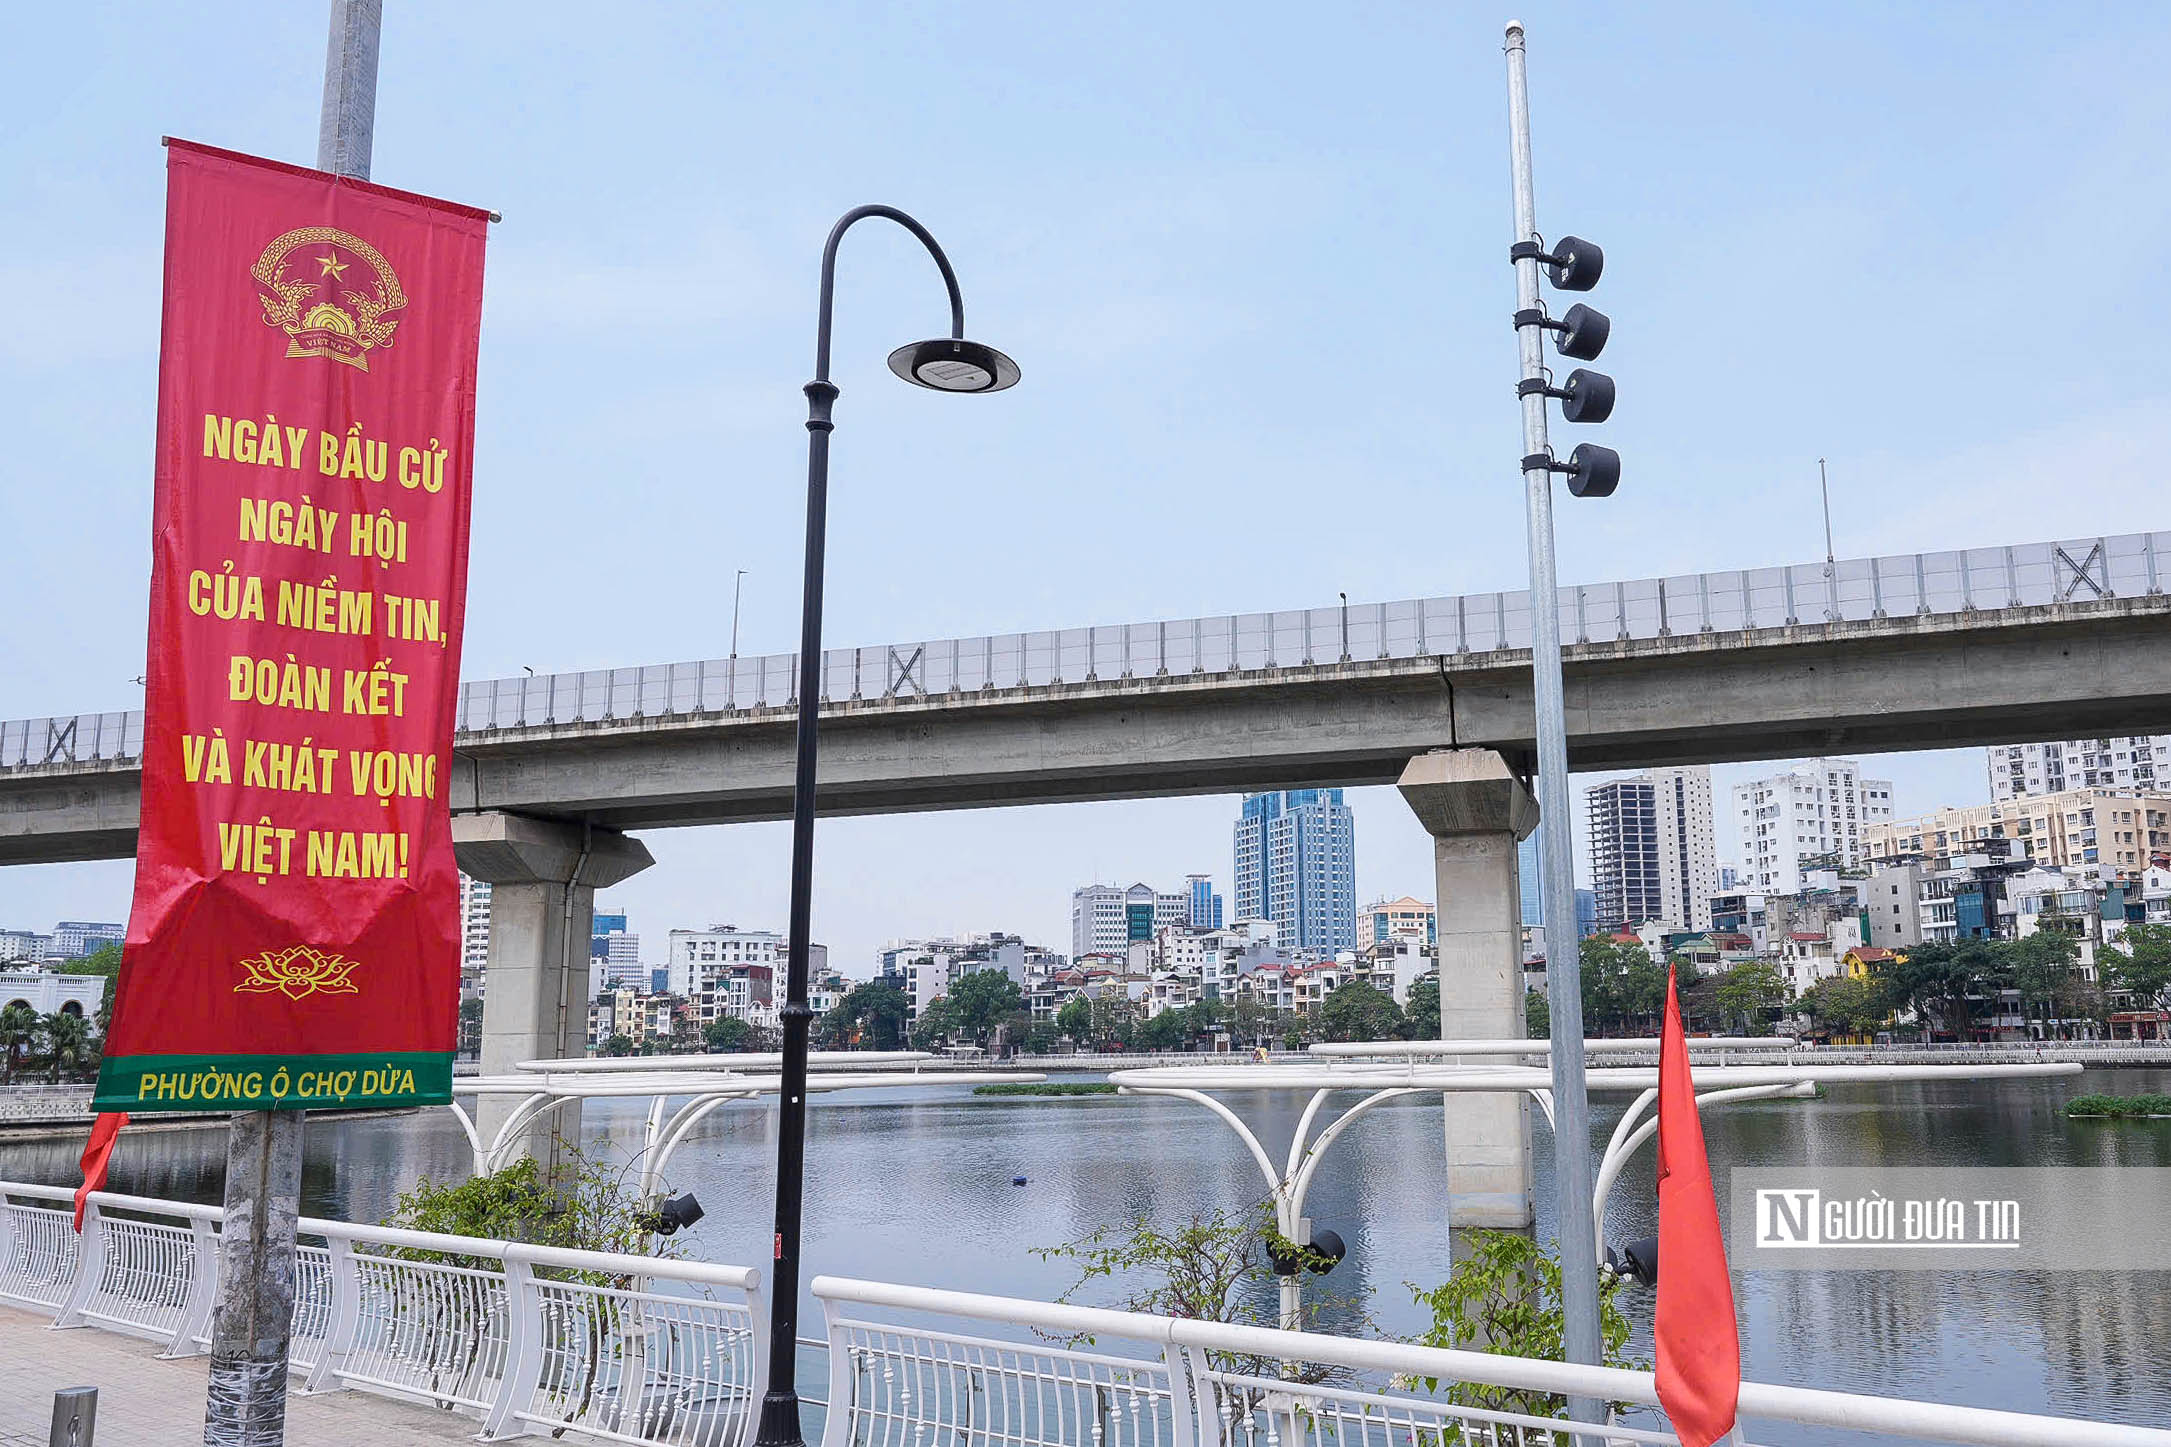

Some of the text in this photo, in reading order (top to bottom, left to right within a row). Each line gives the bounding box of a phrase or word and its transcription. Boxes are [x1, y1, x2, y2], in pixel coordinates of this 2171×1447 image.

[203, 414, 449, 493] NGÀY BẦU CỬ
[239, 495, 407, 569] NGÀY HỘI
[188, 560, 447, 649] CỦA NIỀM TIN,
[228, 653, 409, 717] ĐOÀN KẾT
[182, 728, 437, 807] VÀ KHÁT VỌNG
[218, 816, 409, 885] VIỆT NAM!
[138, 1063, 416, 1103] PHƯỜNG Ô CHỢ DỪA
